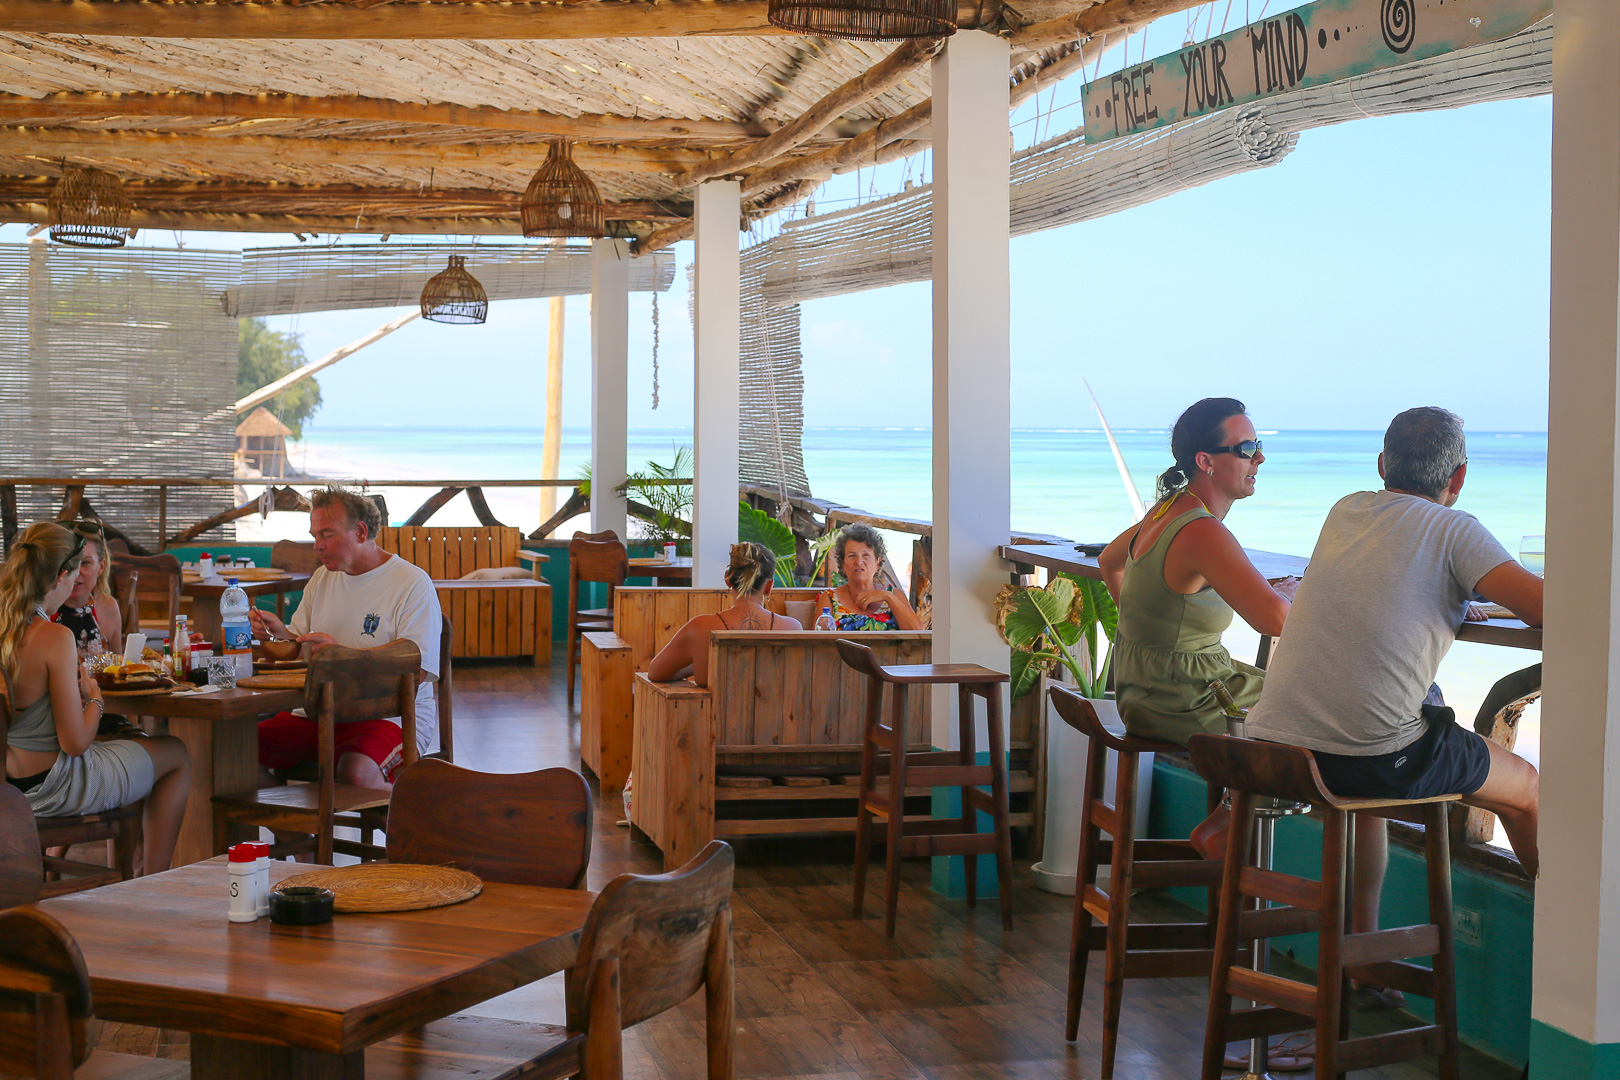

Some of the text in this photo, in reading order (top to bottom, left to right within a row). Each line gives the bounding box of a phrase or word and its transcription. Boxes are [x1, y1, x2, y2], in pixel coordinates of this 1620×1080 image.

[1111, 13, 1308, 136] FREE YOUR MIND
[230, 882, 239, 898] S
